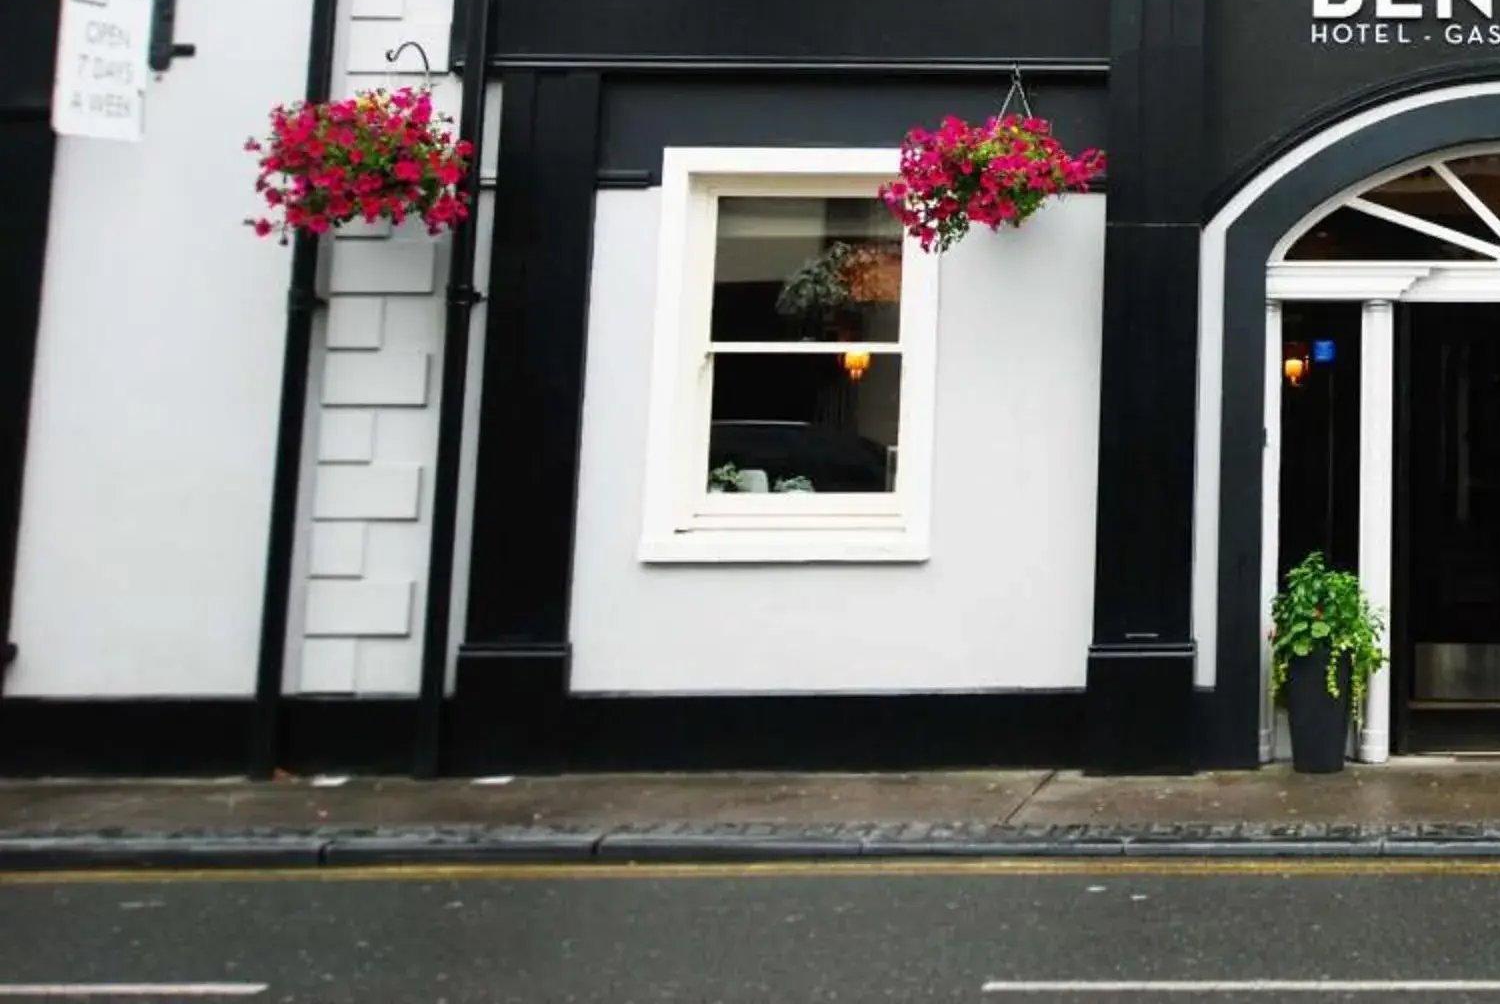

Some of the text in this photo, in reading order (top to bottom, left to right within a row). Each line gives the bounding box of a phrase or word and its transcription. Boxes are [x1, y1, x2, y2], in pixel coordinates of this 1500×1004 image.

[86, 20, 132, 49] OPEN
[1311, 23, 1411, 45] HOTEL
[92, 56, 134, 86] DAYS
